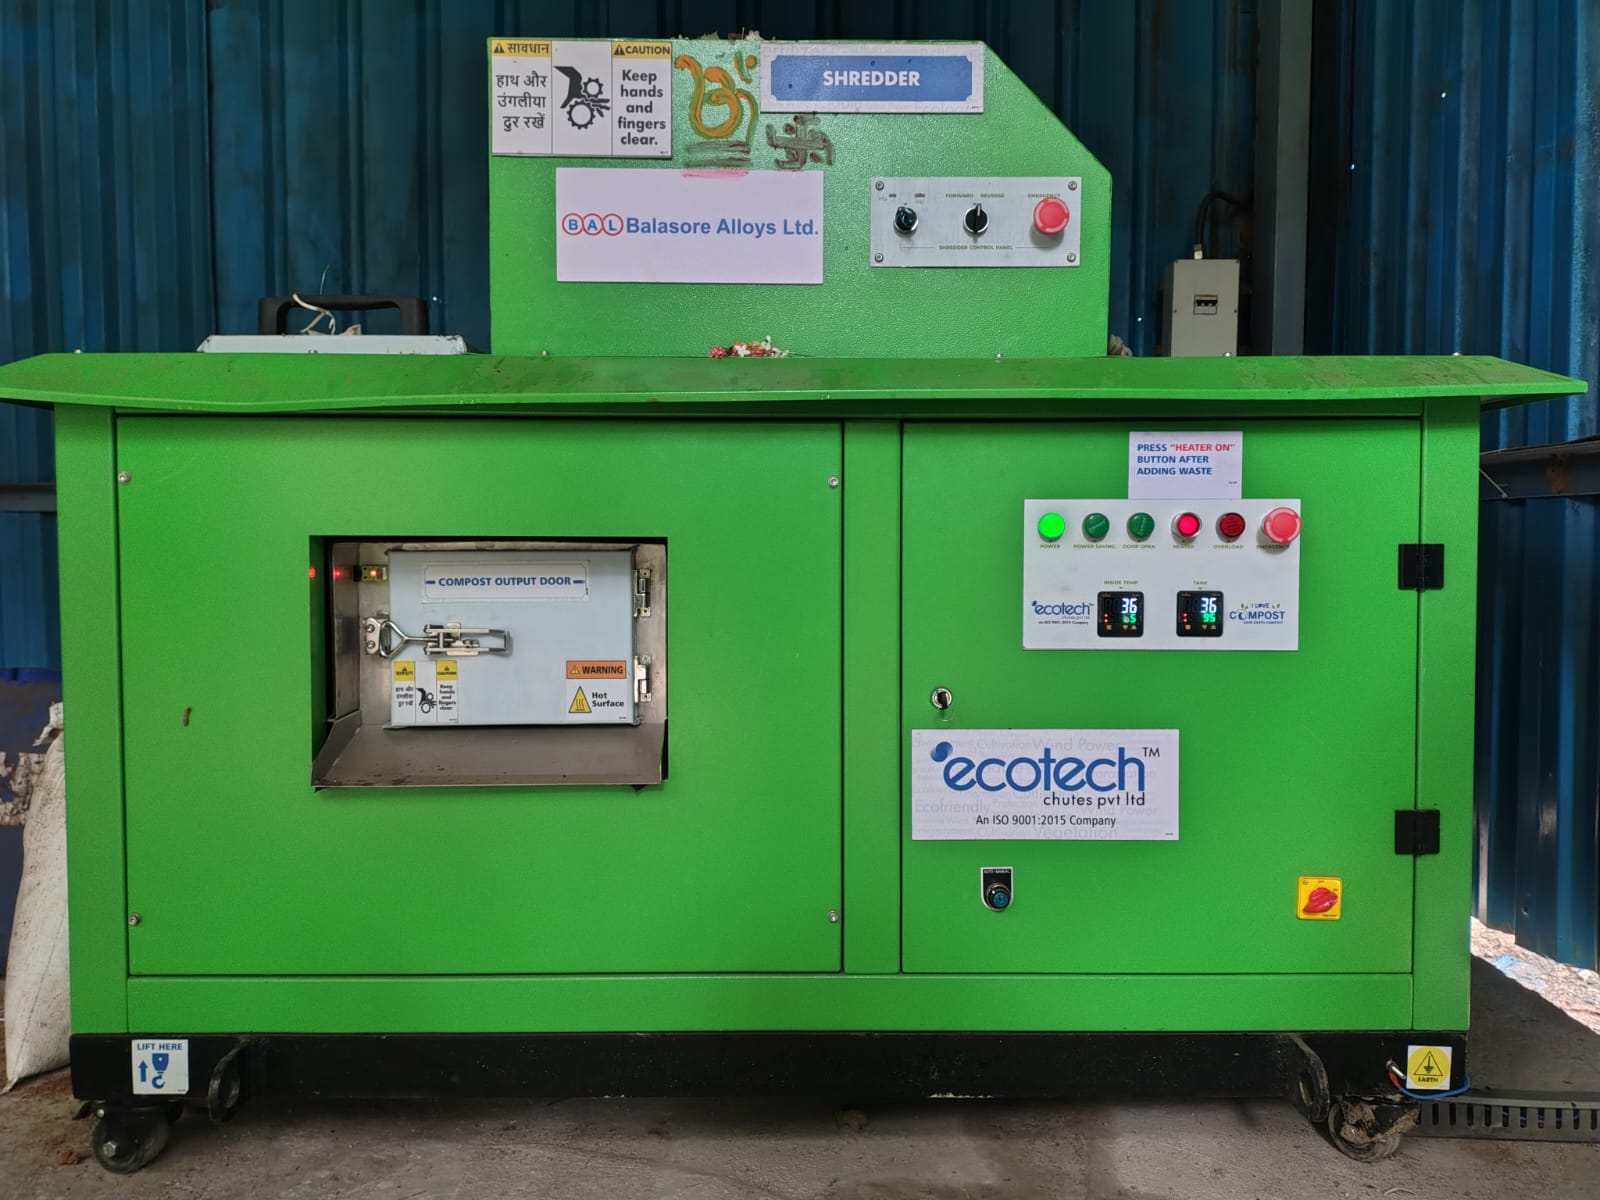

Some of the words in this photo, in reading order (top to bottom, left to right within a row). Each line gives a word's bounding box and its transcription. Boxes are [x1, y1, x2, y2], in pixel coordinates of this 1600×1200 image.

[507, 43, 549, 54] सावधान
[625, 46, 670, 55] CAUTION
[496, 75, 520, 88] हाथ
[524, 71, 548, 88] और
[622, 69, 657, 84] Keep
[823, 70, 920, 87] SHREDDER
[620, 85, 663, 98] hands
[626, 101, 653, 113] and
[523, 112, 545, 128] रखें
[618, 116, 666, 133] fingers
[620, 132, 658, 145] clear.
[626, 218, 711, 234] Balasore
[716, 218, 777, 238] Alloys
[783, 219, 819, 235] Ltd.
[1137, 443, 1167, 452] PRESS
[1137, 455, 1176, 464] BUTTON
[1179, 455, 1209, 464] AFTER
[1136, 467, 1176, 475] ADDING
[1179, 467, 1212, 475] WASTE
[438, 577, 491, 587] COMPOST
[495, 577, 536, 586] OUTPUT
[540, 576, 571, 585] DOOR
[1034, 602, 1090, 615] ecotech
[1121, 598, 1137, 613] 36
[1200, 597, 1217, 613] 36
[582, 666, 623, 674] WARNING
[943, 747, 1145, 792] ecotech
[1043, 792, 1092, 806] chutes
[1097, 793, 1120, 809] pvt
[1126, 792, 1145, 806] ltd
[976, 815, 990, 825] An
[992, 815, 1009, 825] ISO
[1012, 815, 1066, 825] 9001:2015
[1069, 815, 1116, 828] Company
